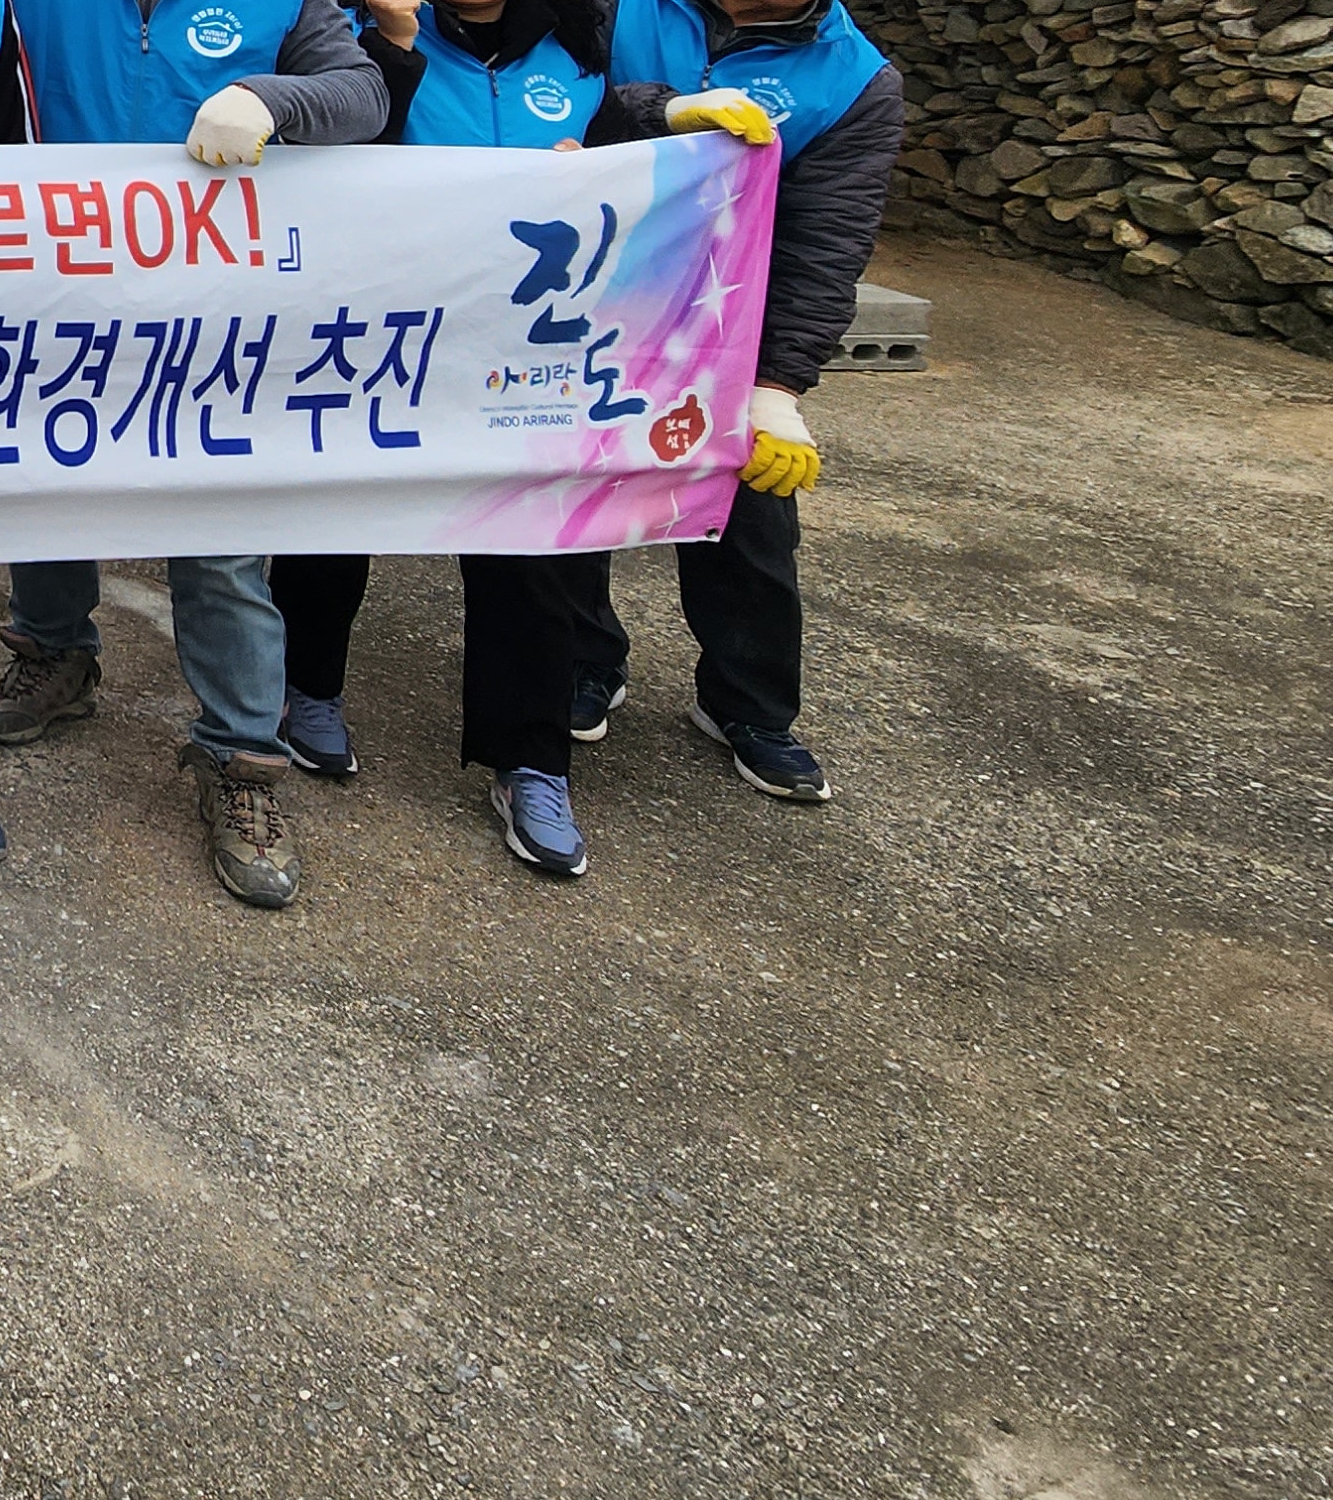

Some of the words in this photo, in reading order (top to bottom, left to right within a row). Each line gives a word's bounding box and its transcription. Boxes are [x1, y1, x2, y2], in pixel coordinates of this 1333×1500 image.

[285, 306, 445, 454] 추진
[487, 415, 521, 429] JINDO
[522, 413, 574, 426] ARIRANG
